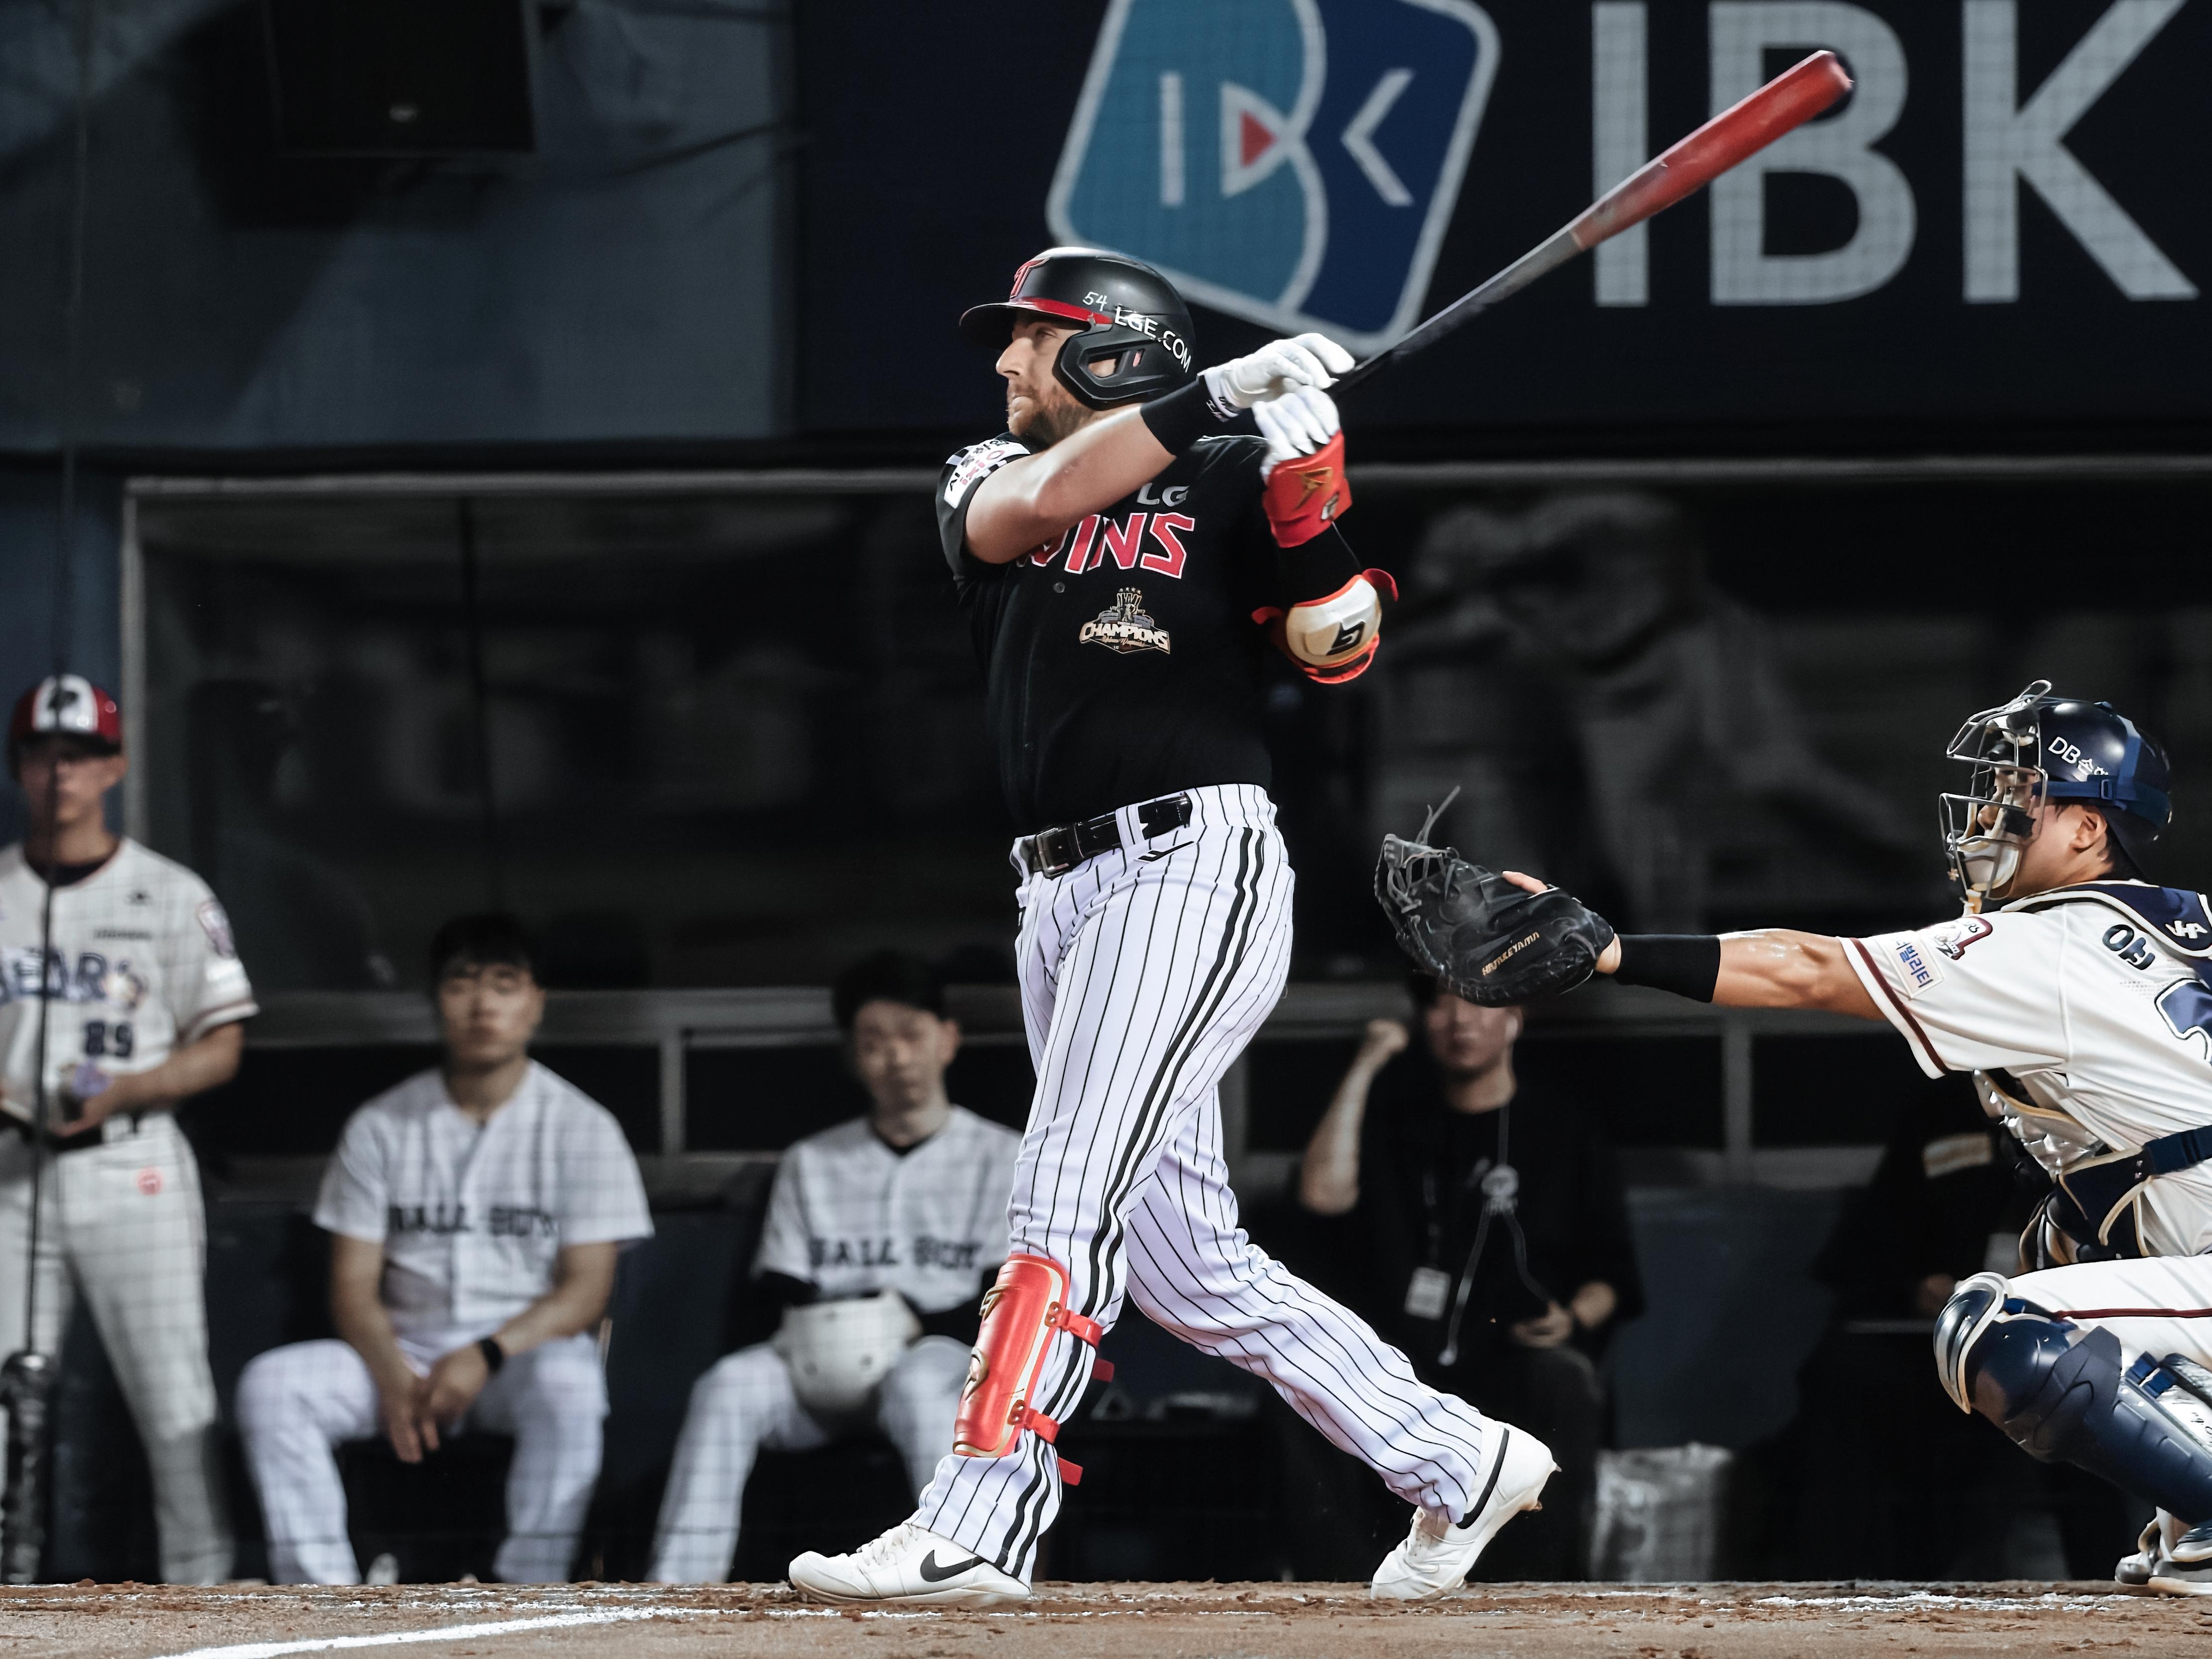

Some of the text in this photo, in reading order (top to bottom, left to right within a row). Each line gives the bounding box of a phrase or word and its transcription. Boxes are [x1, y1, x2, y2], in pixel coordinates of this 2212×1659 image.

[1592, 0, 2200, 307] IBK
[1082, 291, 1107, 312] 54
[1114, 305, 1192, 373] LGE.COM
[1136, 482, 1190, 507] LG
[1080, 622, 1169, 652] CHAMPIONS
